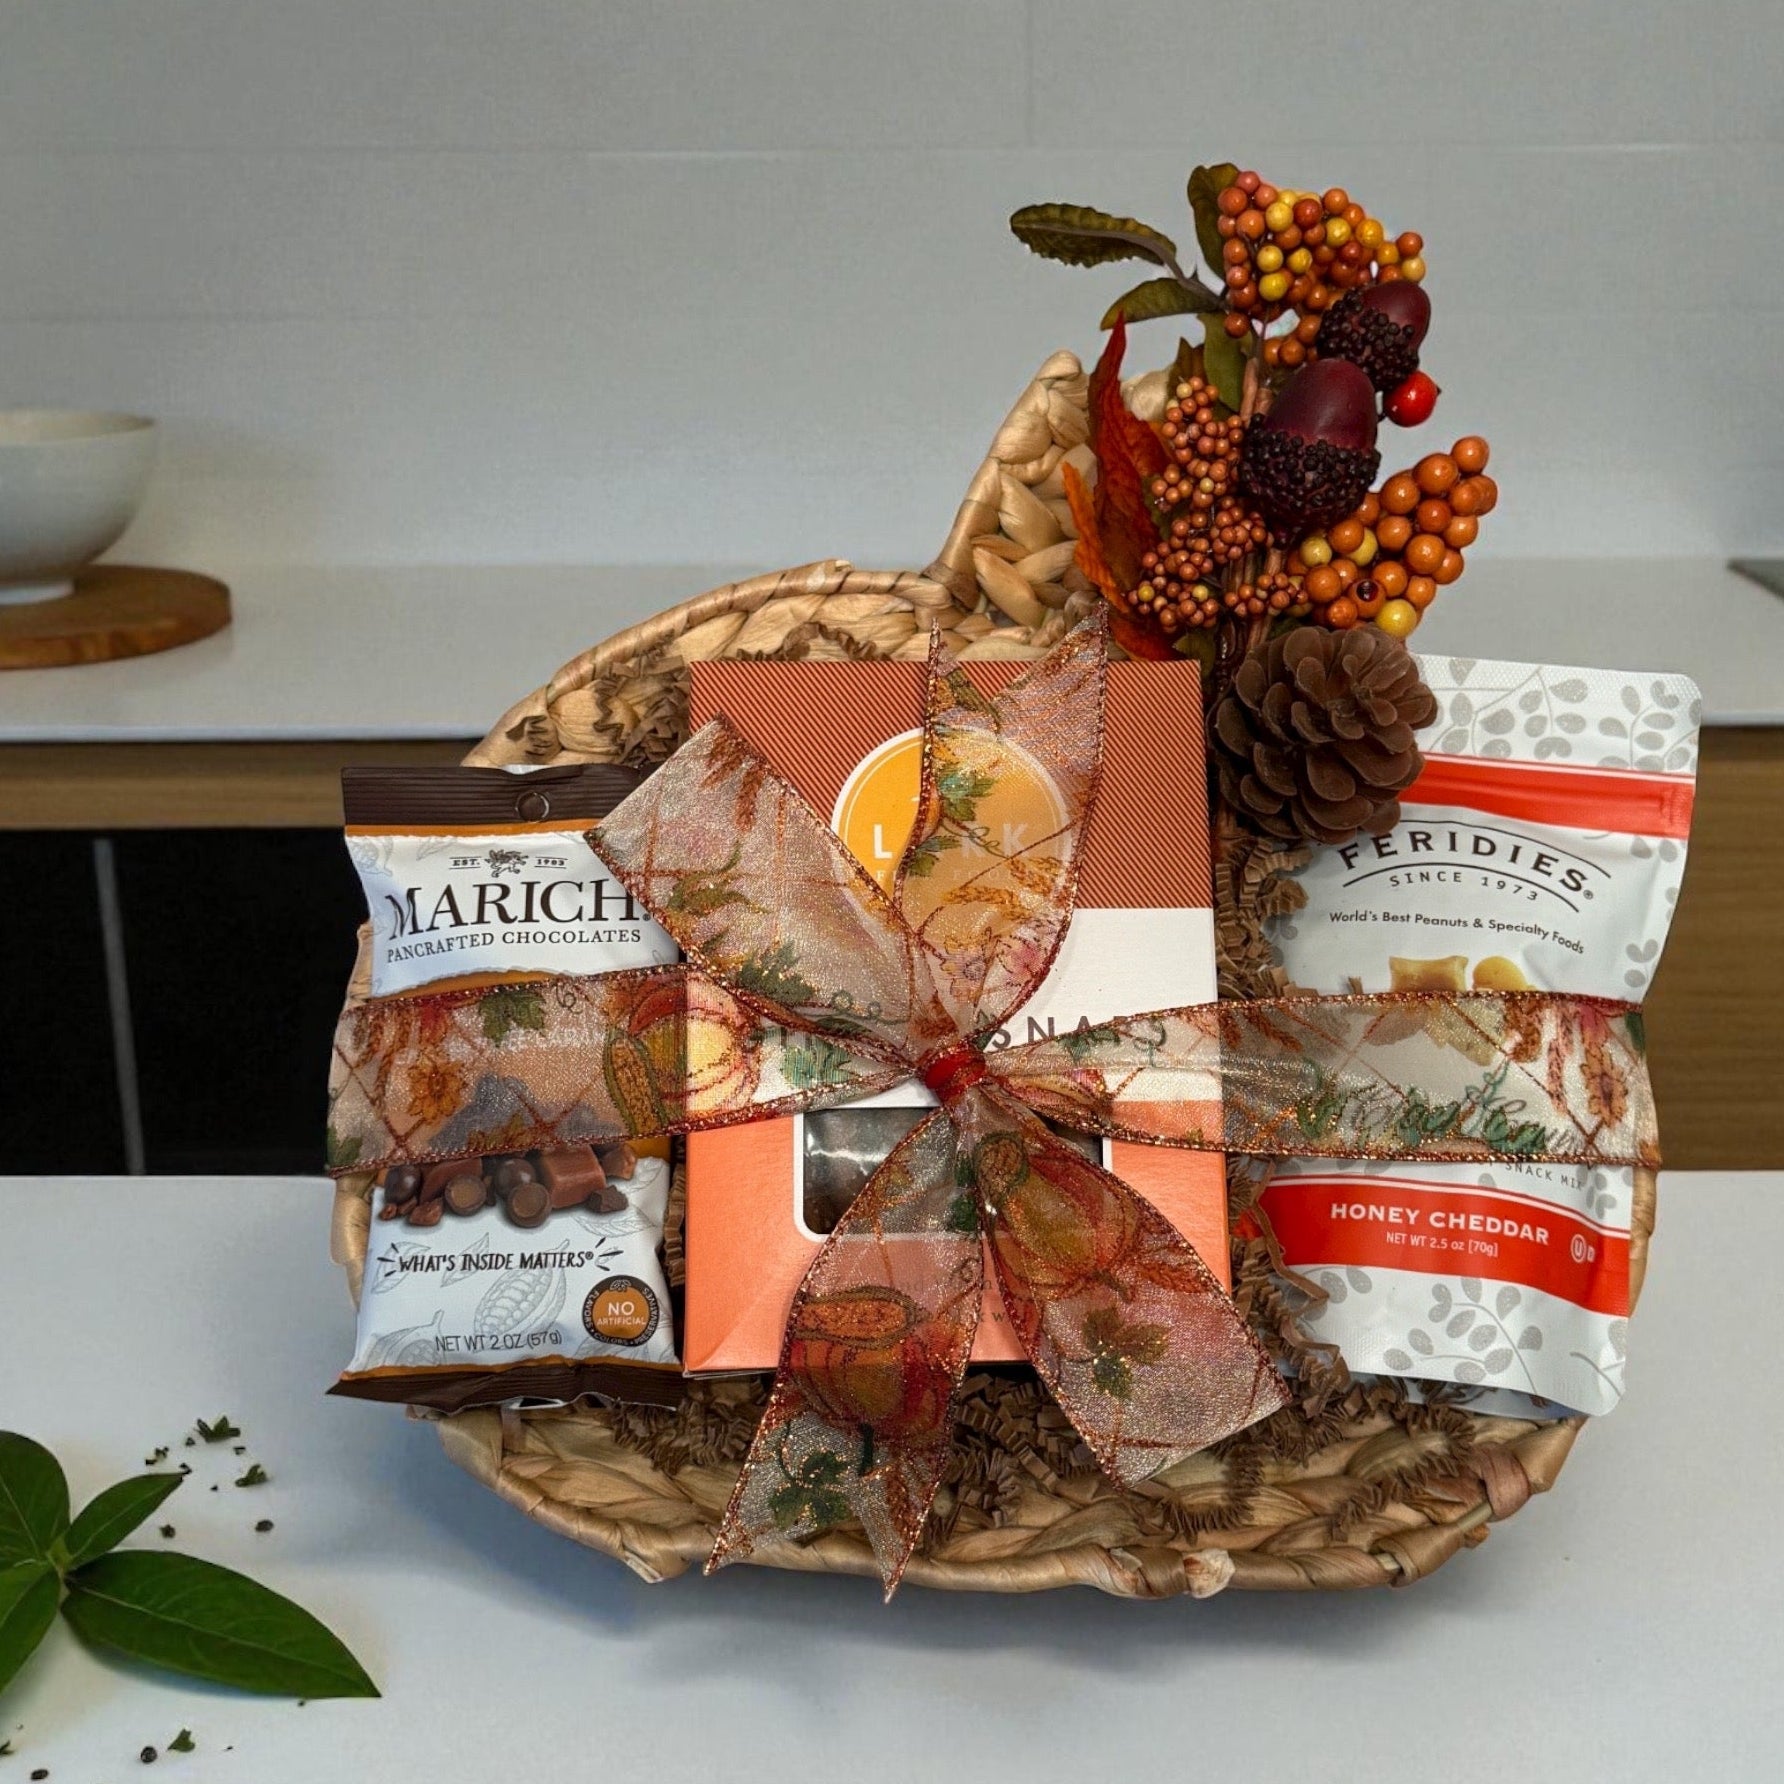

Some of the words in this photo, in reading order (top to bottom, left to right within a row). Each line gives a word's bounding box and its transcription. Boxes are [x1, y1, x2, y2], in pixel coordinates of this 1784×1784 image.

[452, 858, 481, 867] EST.
[1389, 871, 1462, 888] SINCE
[1482, 876, 1538, 901] 1973
[1329, 910, 1378, 923] World's
[1382, 912, 1411, 923] Best
[1414, 914, 1469, 928] Peanuts
[1472, 918, 1484, 929] &
[1488, 919, 1550, 941] Specialty
[1551, 930, 1584, 955] Foods
[387, 931, 495, 964] PANCRAFTED
[502, 929, 641, 945] CHOCOLATES
[1331, 1203, 1420, 1225] HONEY
[1429, 1211, 1549, 1246] CHEDDAR
[1386, 1231, 1408, 1244] NET
[1410, 1234, 1427, 1247] WT
[1429, 1238, 1448, 1249] 2.5
[1450, 1239, 1465, 1250] oz
[1467, 1239, 1499, 1258] [70g]
[399, 1253, 456, 1273] WHAT'S
[461, 1254, 515, 1271] INSIDE
[583, 1289, 600, 1330] FLAVORS
[596, 1316, 646, 1326] ARTIFICIAL
[607, 1301, 635, 1316] NO
[435, 1335, 461, 1352] NET
[464, 1334, 486, 1351] WT
[489, 1334, 501, 1350] 2
[503, 1333, 525, 1350] OZ
[526, 1329, 563, 1349] (57g)
